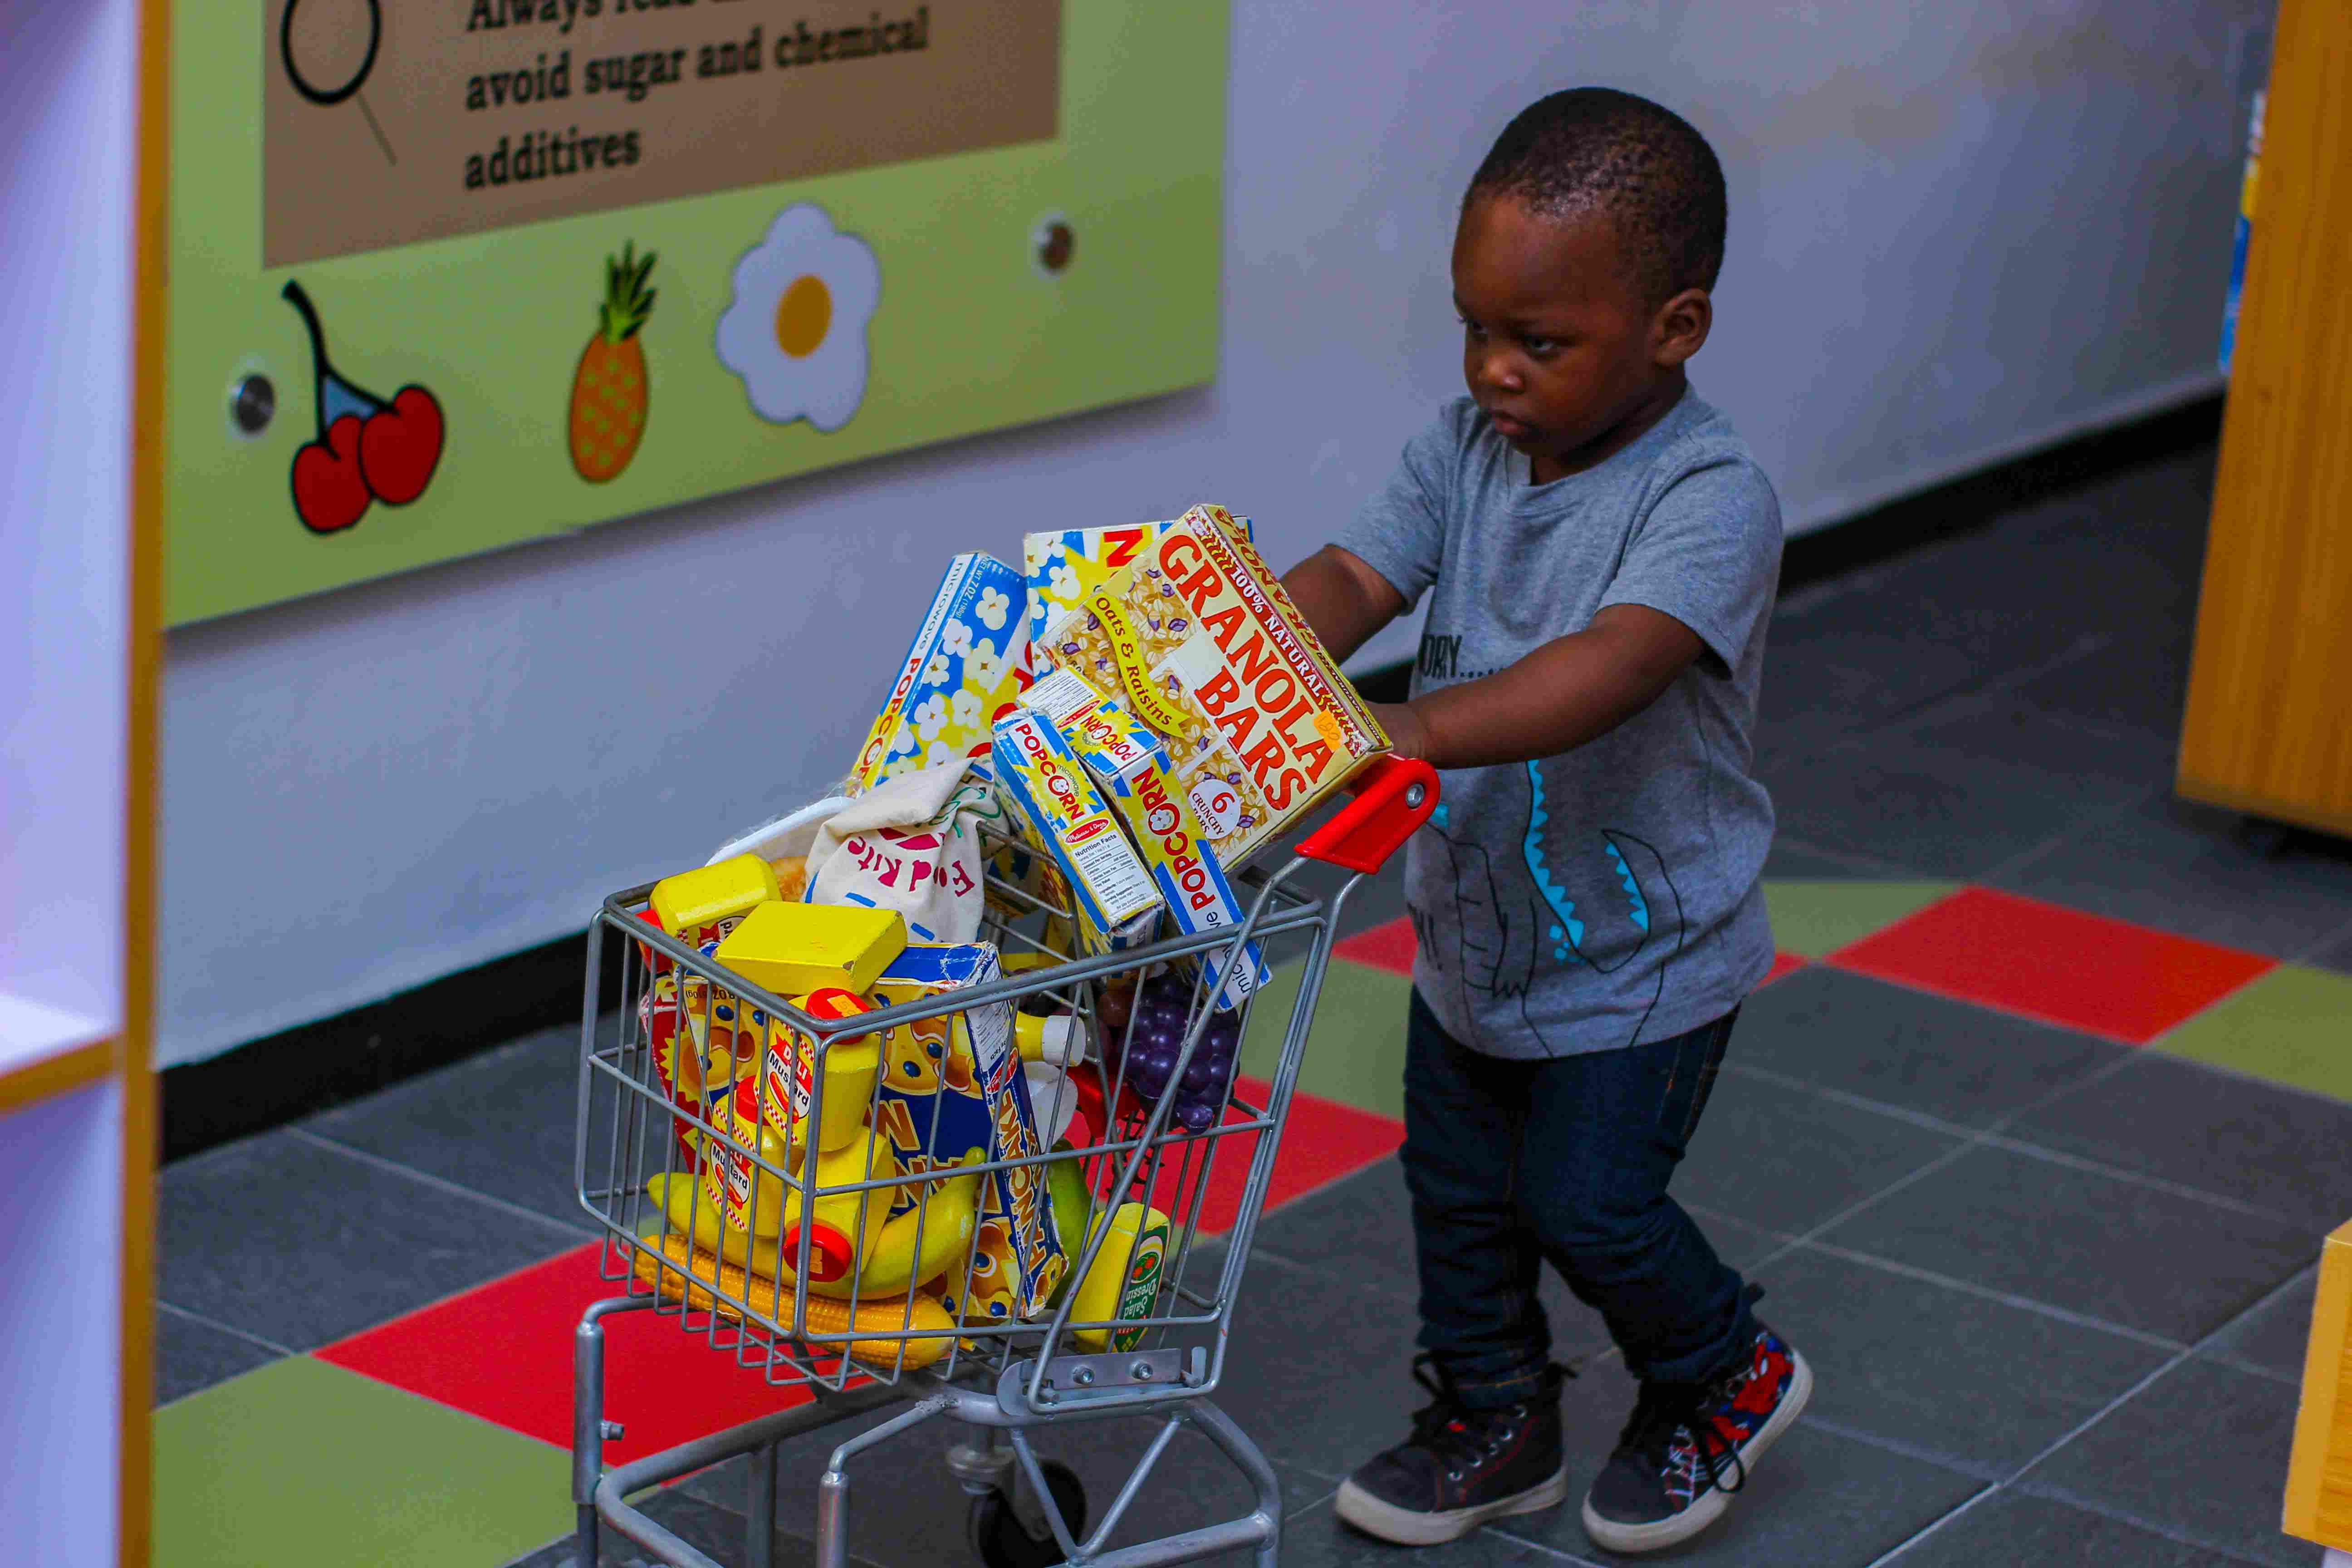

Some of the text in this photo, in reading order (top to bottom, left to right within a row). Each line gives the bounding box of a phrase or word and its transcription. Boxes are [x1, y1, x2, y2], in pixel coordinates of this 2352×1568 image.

[466, 6, 929, 110] avoid sugar and chemical
[464, 123, 640, 190] additives
[1095, 596, 1126, 638] Oats
[1121, 642, 1131, 660] &
[1126, 665, 1173, 726] Raisins
[1158, 534, 1334, 785] GRANOLA
[1230, 567, 1321, 697] 100% NATURAL
[862, 562, 964, 781] microwave POPCOR
[1080, 715, 1138, 761] POPCORN
[1194, 666, 1308, 811] BARS
[1014, 722, 1085, 821] POPCORN
[1057, 763, 1080, 798] microwave
[1192, 793, 1224, 835] CRUNCHY
[1212, 792, 1235, 813] 6
[1074, 833, 1117, 857] Nutrition Facts
[1132, 765, 1216, 911] POPCORN
[1206, 911, 1252, 994] micove
[769, 1054, 810, 1107] Musard
[783, 1044, 808, 1078] DLI
[711, 1147, 748, 1190] Mutard
[1123, 1296, 1148, 1320] Salad
[1126, 1278, 1157, 1304] Dressin
